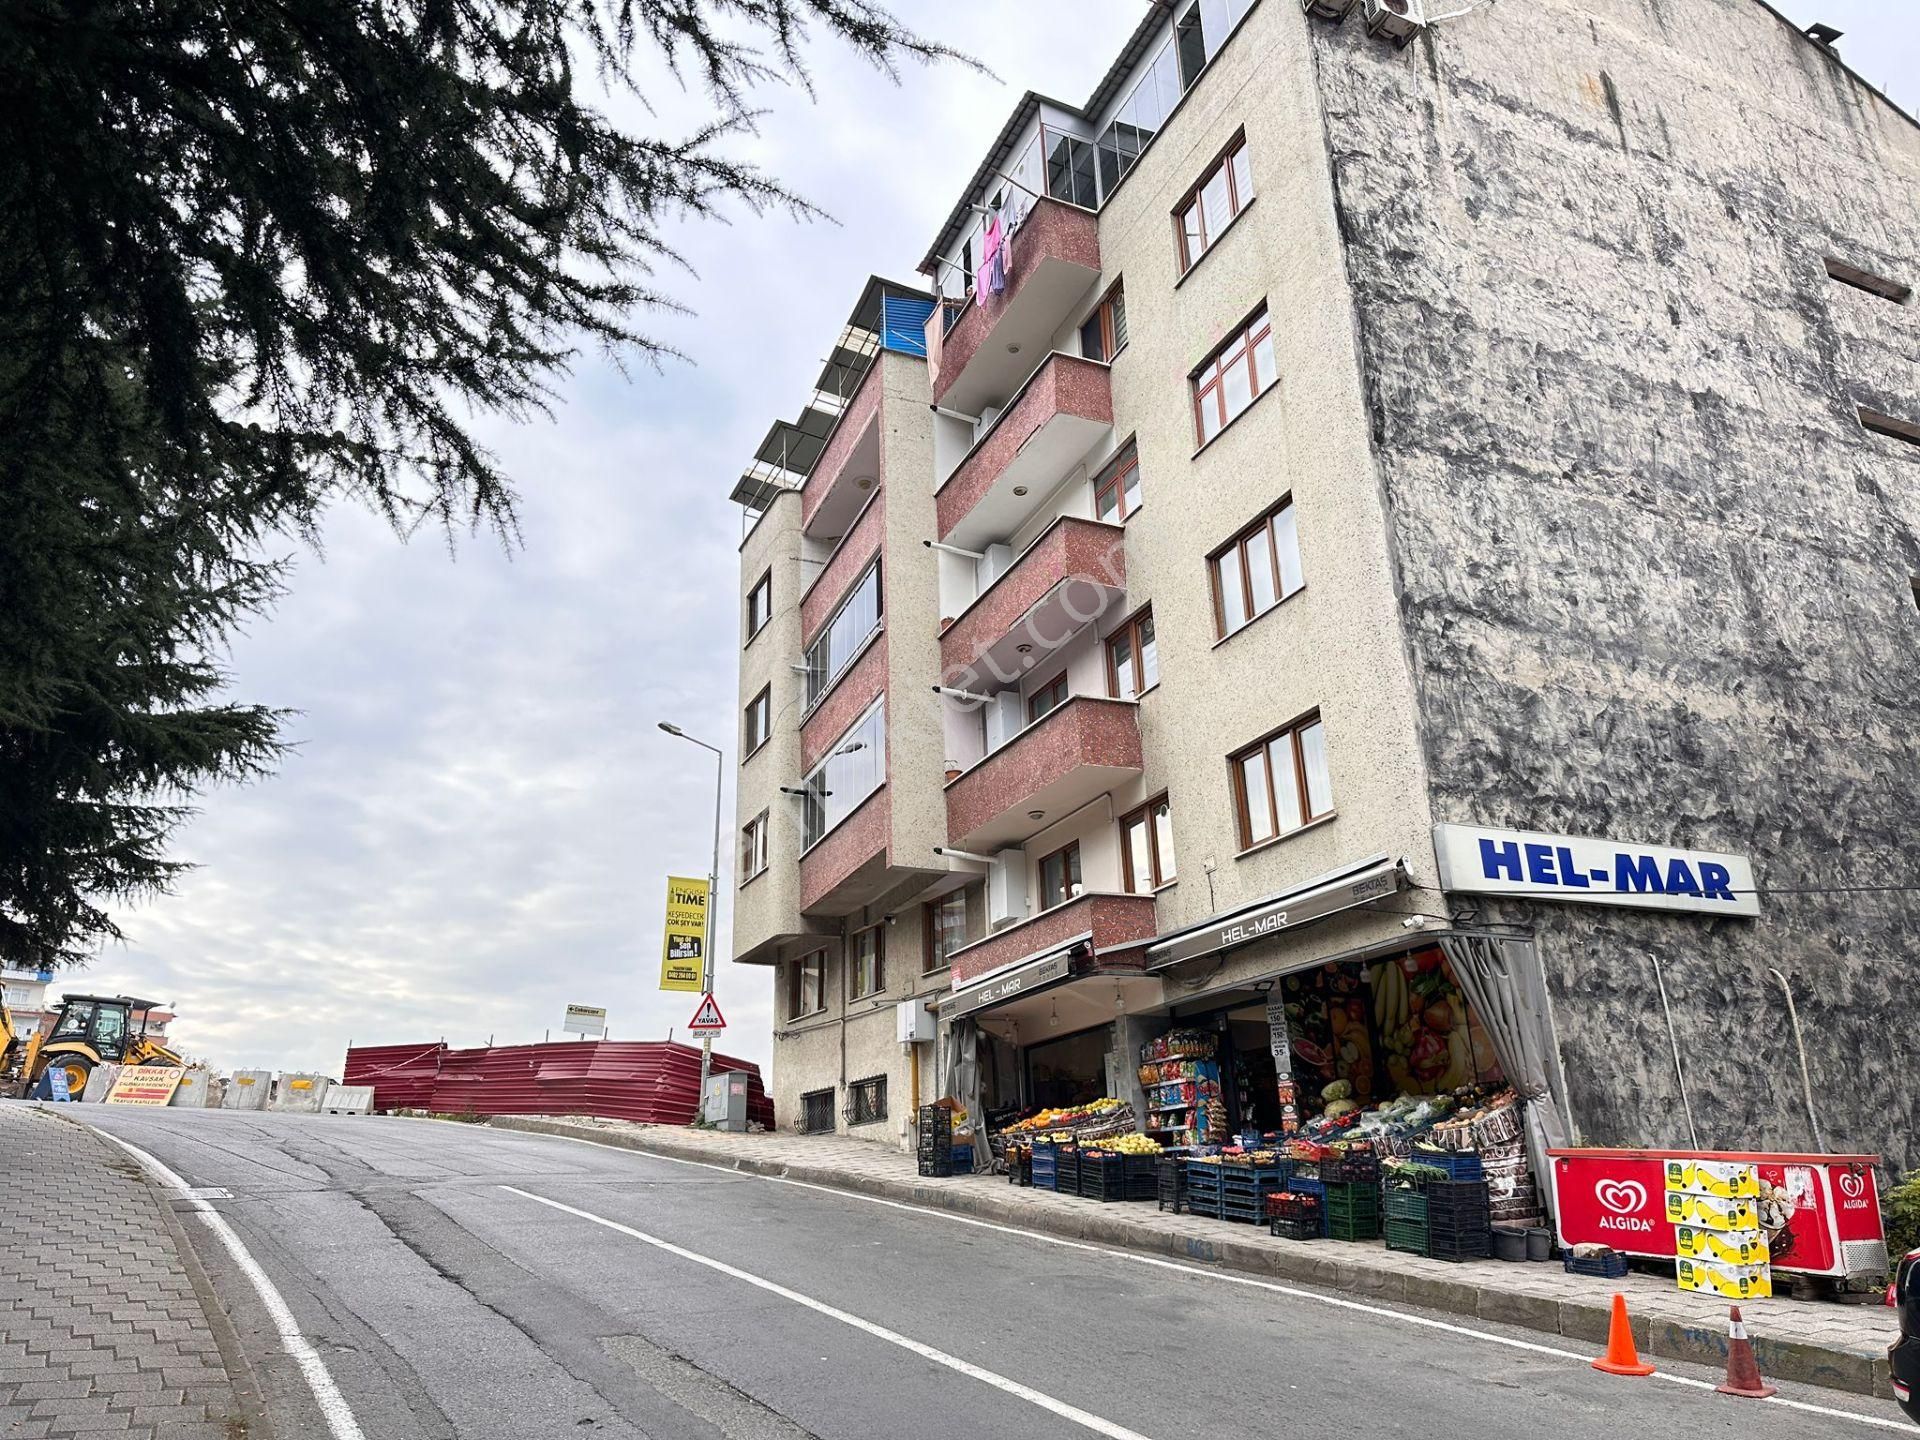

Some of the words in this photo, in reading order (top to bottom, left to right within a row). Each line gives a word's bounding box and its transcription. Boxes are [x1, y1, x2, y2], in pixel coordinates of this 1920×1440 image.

[1478, 838, 1737, 901] HEL-MAR
[676, 893, 704, 906] TIME
[1221, 911, 1288, 944] HEL-MAR
